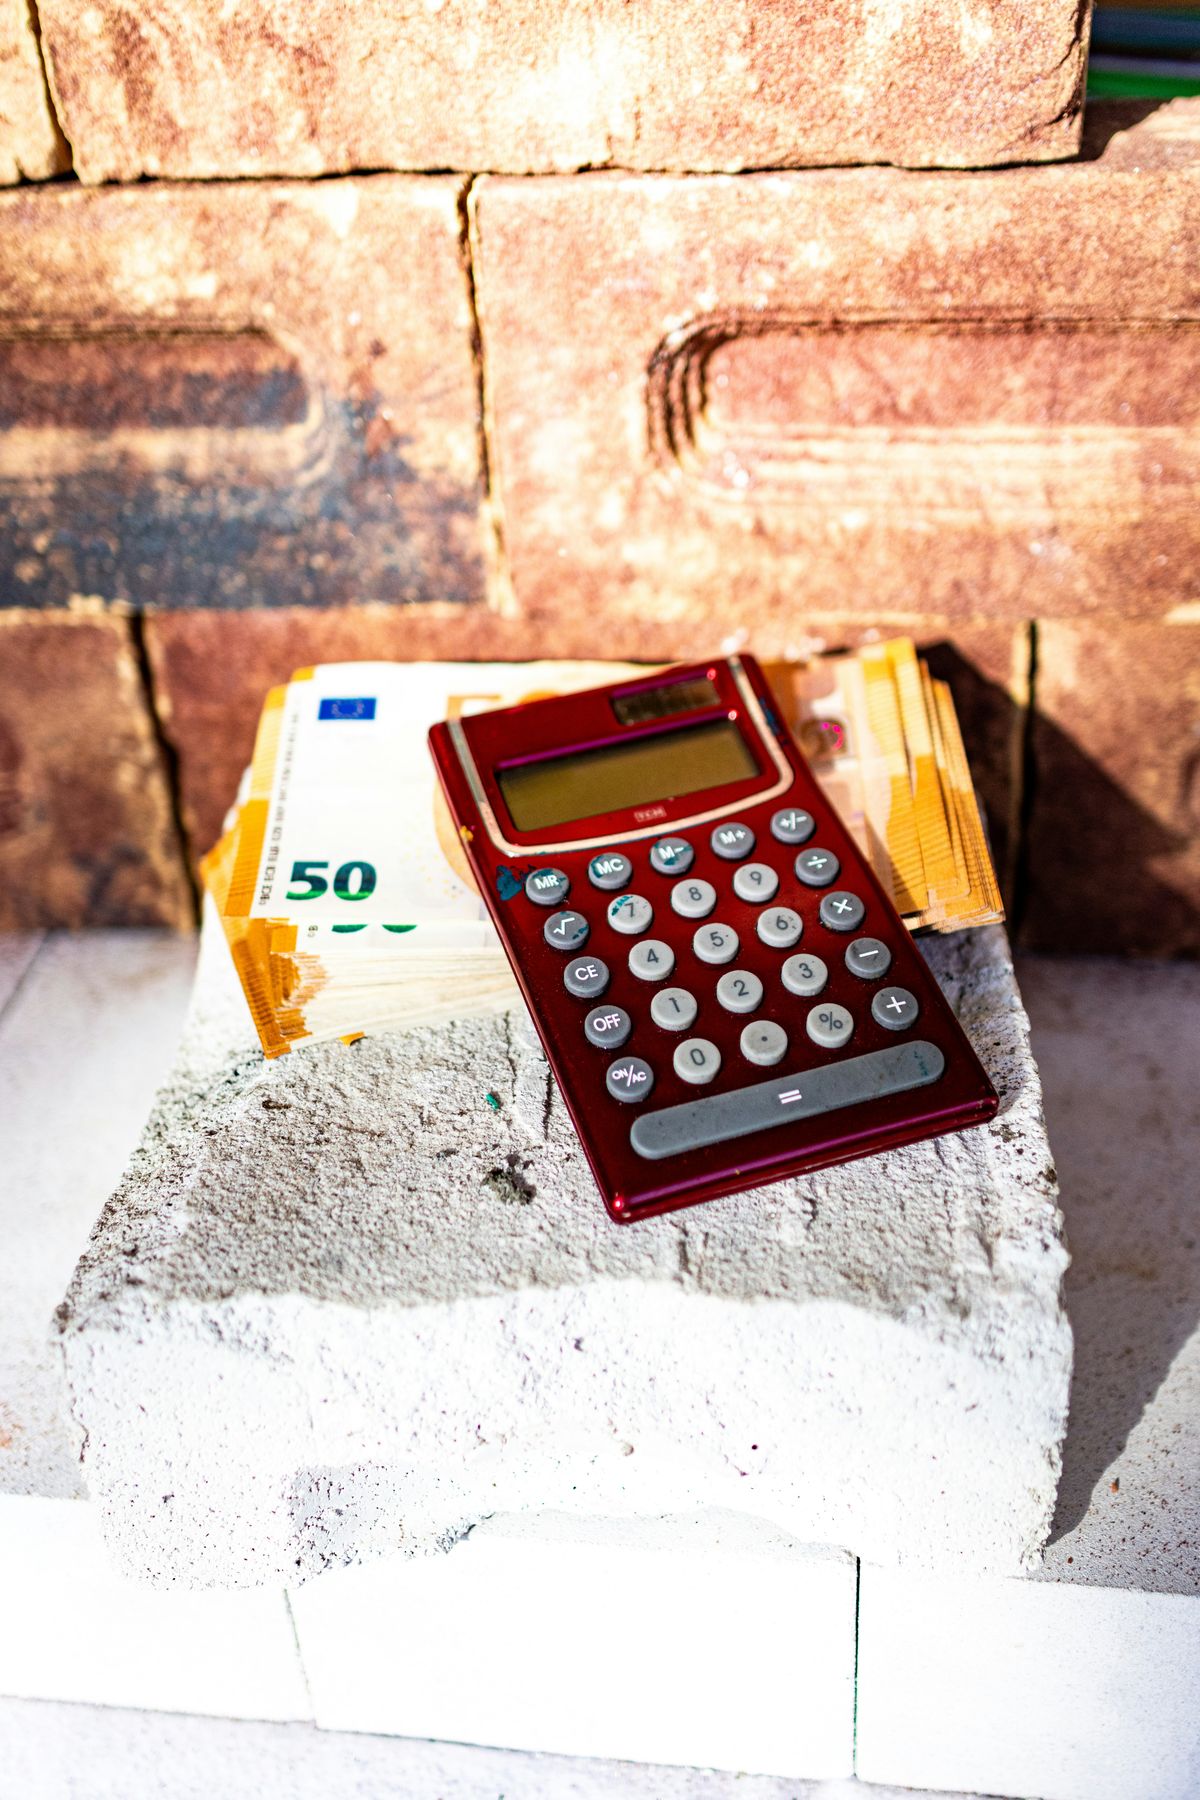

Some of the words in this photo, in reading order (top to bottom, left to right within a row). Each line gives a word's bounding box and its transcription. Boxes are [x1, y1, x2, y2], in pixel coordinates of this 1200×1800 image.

[285, 860, 377, 901] 50
[534, 875, 560, 890] MR
[597, 858, 624, 875] MC
[719, 829, 746, 844] M+
[624, 902, 634, 918] 7
[688, 886, 702, 901] 8
[750, 871, 762, 885] 9
[575, 964, 598, 981] CE
[647, 948, 659, 964] 4
[710, 931, 724, 947] 5
[776, 915, 788, 930] 6
[593, 1013, 621, 1032] OFF
[668, 997, 681, 1013] 1
[733, 979, 749, 997] 2
[798, 963, 813, 979] 3
[690, 1048, 706, 1066] 0
[819, 1011, 843, 1031] %
[886, 996, 906, 1014] +
[778, 1089, 802, 1105] =
